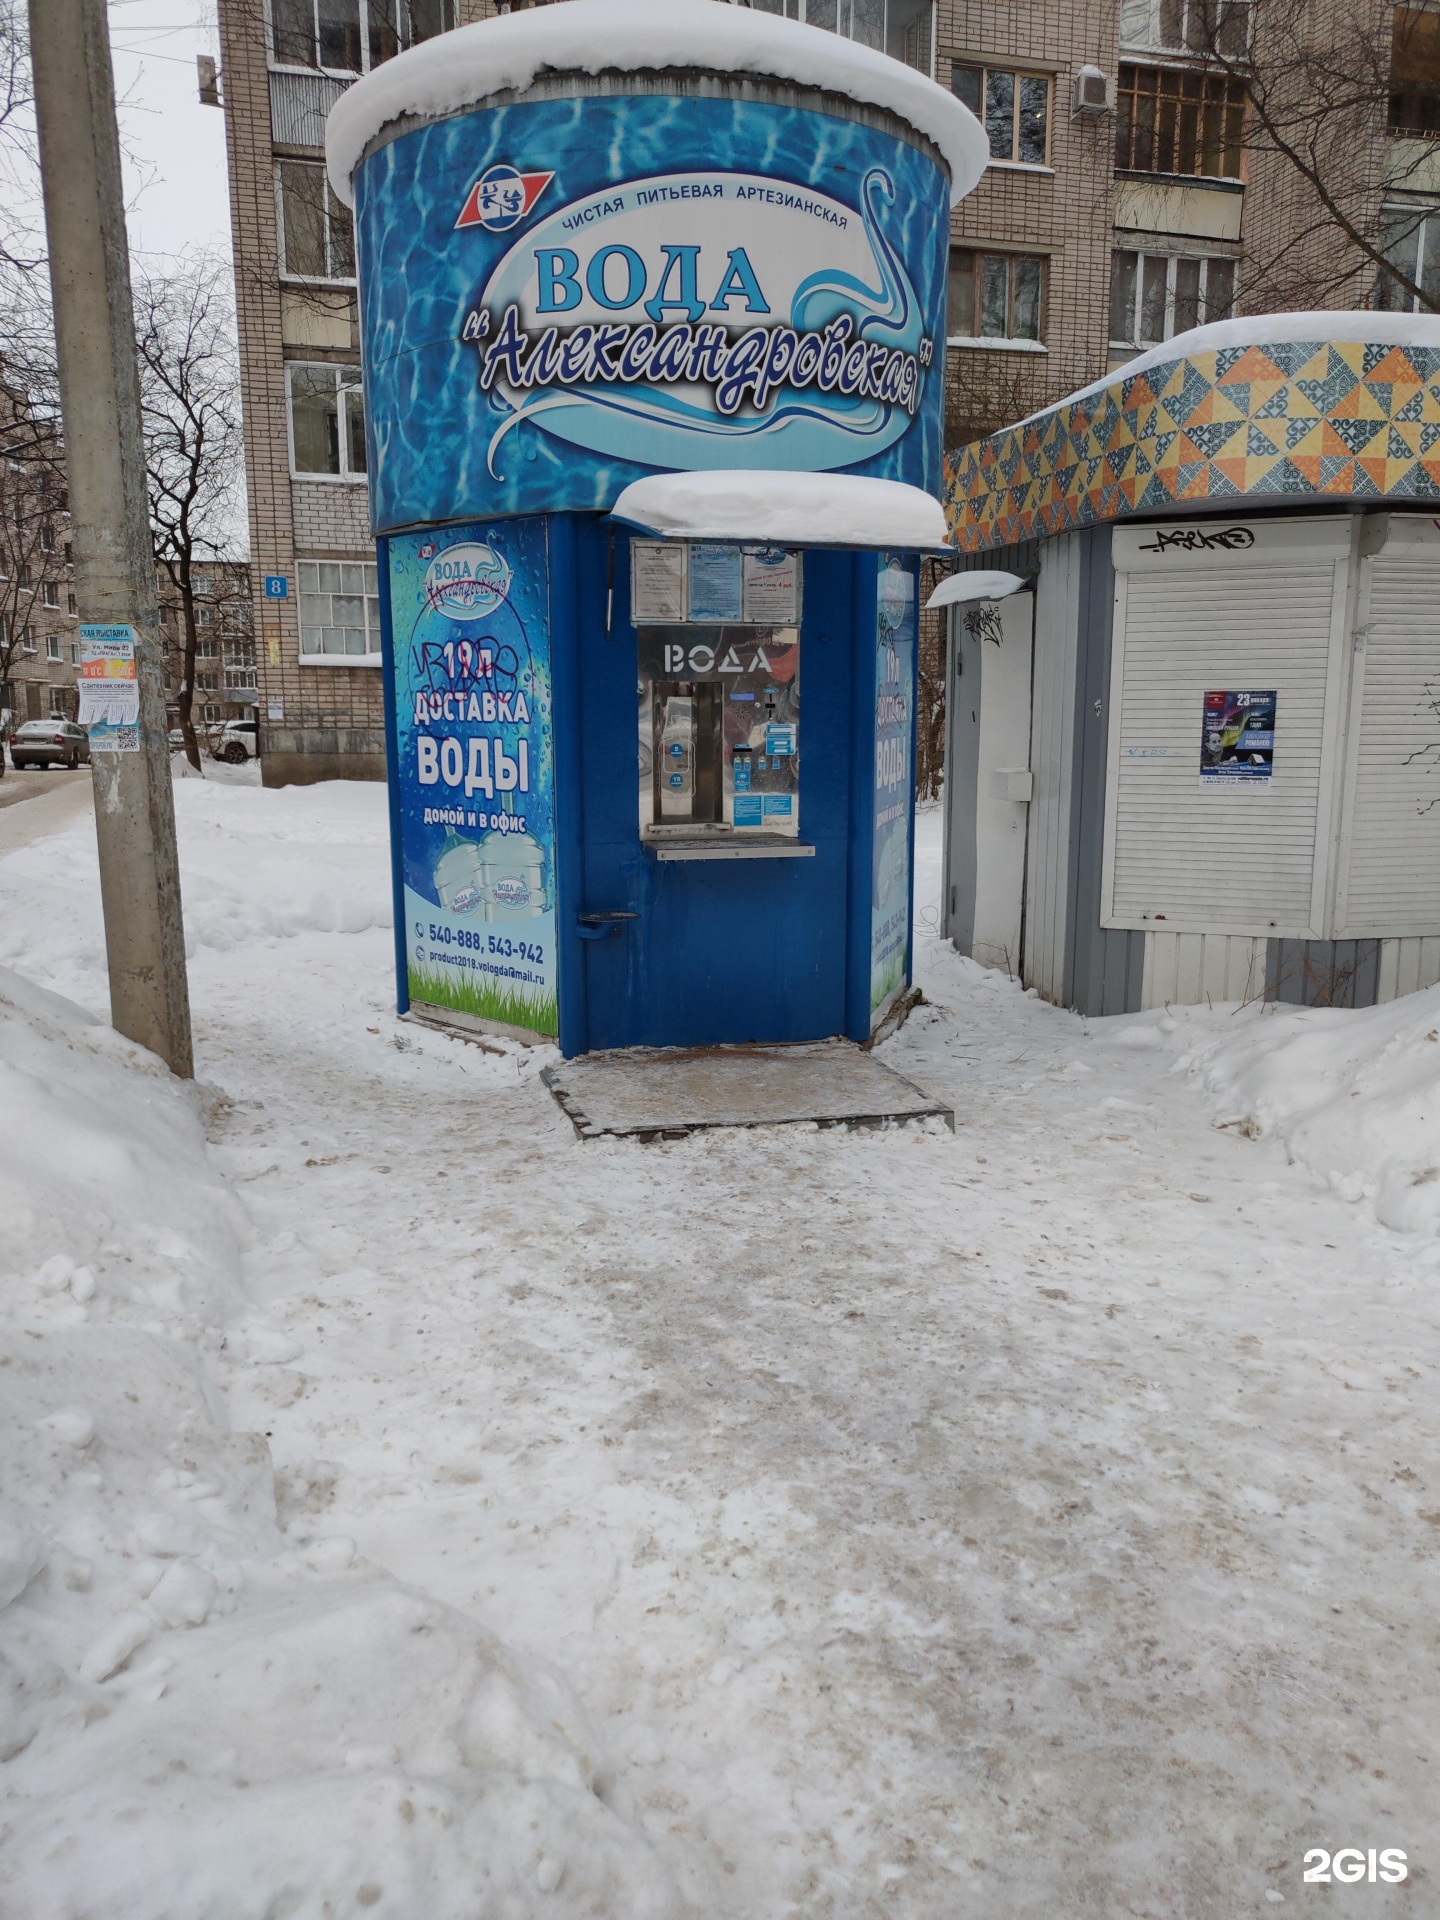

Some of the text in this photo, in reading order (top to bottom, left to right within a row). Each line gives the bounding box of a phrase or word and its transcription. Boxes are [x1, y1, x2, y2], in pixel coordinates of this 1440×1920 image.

[562, 184, 849, 231] ЧИСТАЯ ПИТЬЕВАЯ АРТЕЗИАНСКАЯ
[534, 243, 772, 323] ВОДА
[271, 579, 282, 594] 8
[434, 560, 472, 583] ВОДА
[96, 629, 129, 638] ВЫСТАВКА
[664, 645, 773, 672] ВОДА
[413, 691, 530, 726] ДОСТАВКА
[1237, 693, 1251, 706] 23
[417, 736, 529, 799] ВОДЫ
[876, 736, 906, 794] ВОДЫ
[429, 923, 544, 965] 540-888, 543-942
[429, 950, 545, 986] product2018.vologda@mail.ru
